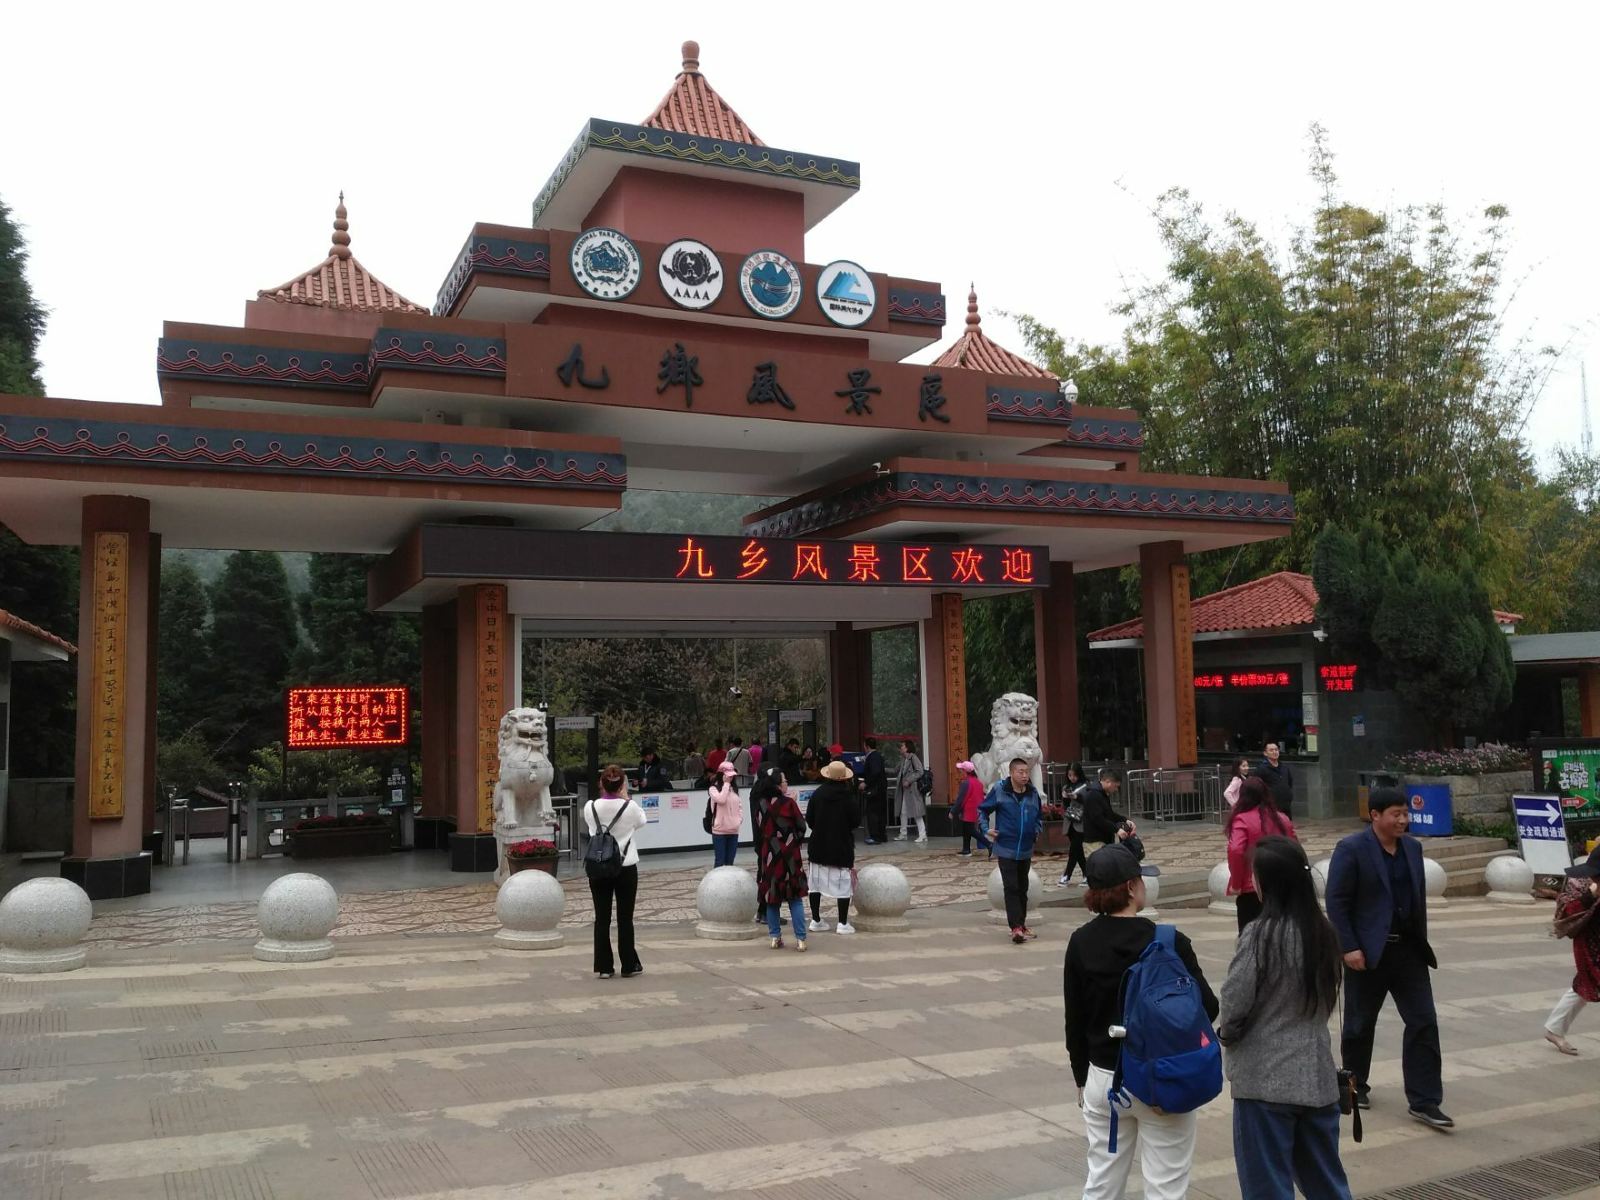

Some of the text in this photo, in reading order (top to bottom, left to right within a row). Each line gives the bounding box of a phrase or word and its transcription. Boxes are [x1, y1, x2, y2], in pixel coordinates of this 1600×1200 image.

[673, 287, 710, 301] AAAA
[676, 537, 1034, 584] 九乡风景区欢迎
[1519, 825, 1565, 838] 安全疏散通道
